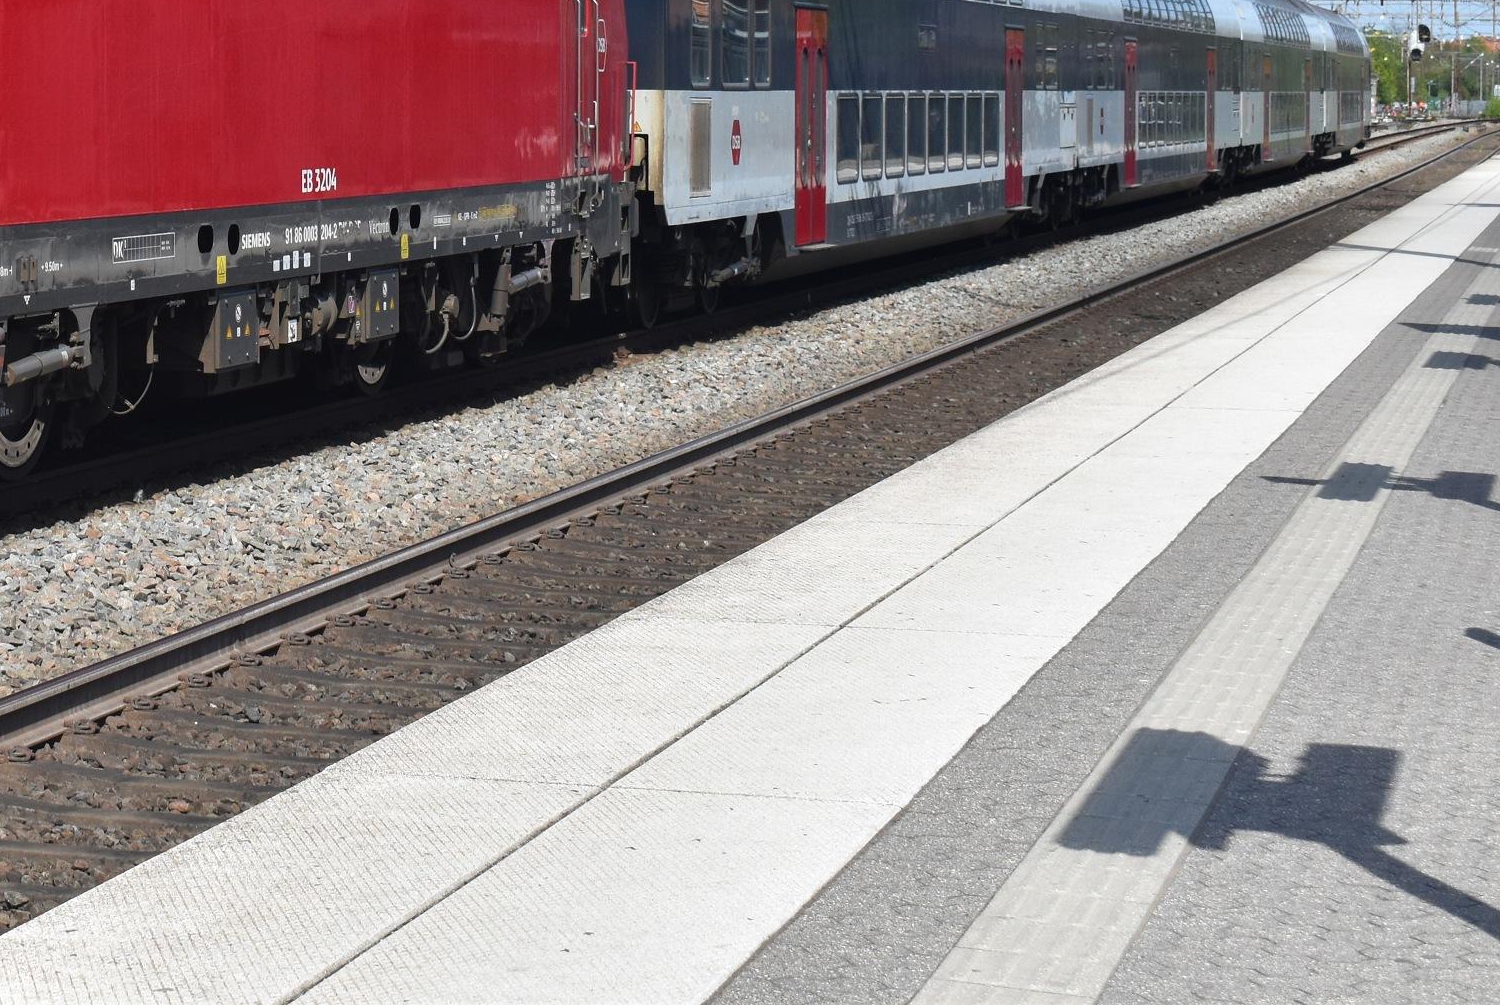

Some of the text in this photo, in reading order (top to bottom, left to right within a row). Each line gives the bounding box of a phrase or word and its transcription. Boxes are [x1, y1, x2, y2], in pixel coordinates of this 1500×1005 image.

[301, 167, 337, 193] EB 3204
[241, 232, 271, 250] SIEMENS
[285, 228, 293, 245] 91
[294, 227, 303, 244] 86
[321, 223, 338, 240] 204-2
